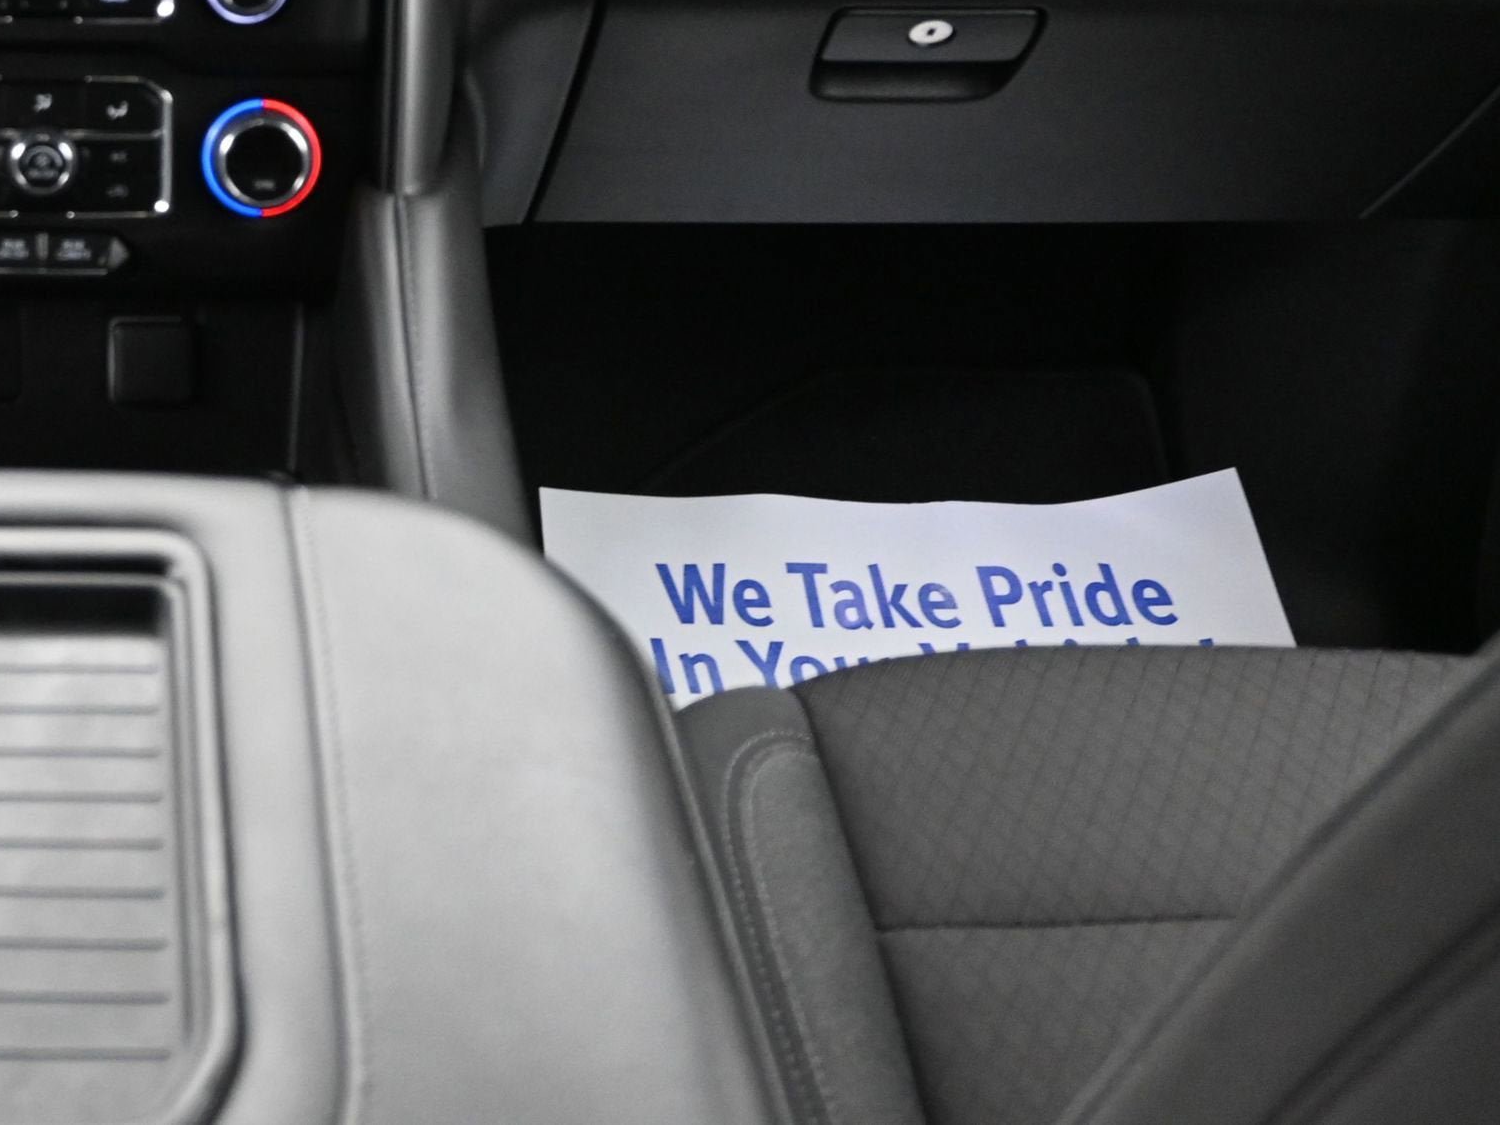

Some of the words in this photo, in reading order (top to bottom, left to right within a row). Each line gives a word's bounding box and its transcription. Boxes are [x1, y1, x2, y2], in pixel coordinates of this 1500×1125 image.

[655, 562, 774, 627] We
[785, 562, 962, 630] Take
[975, 562, 1179, 628] Pride
[649, 637, 724, 694] In
